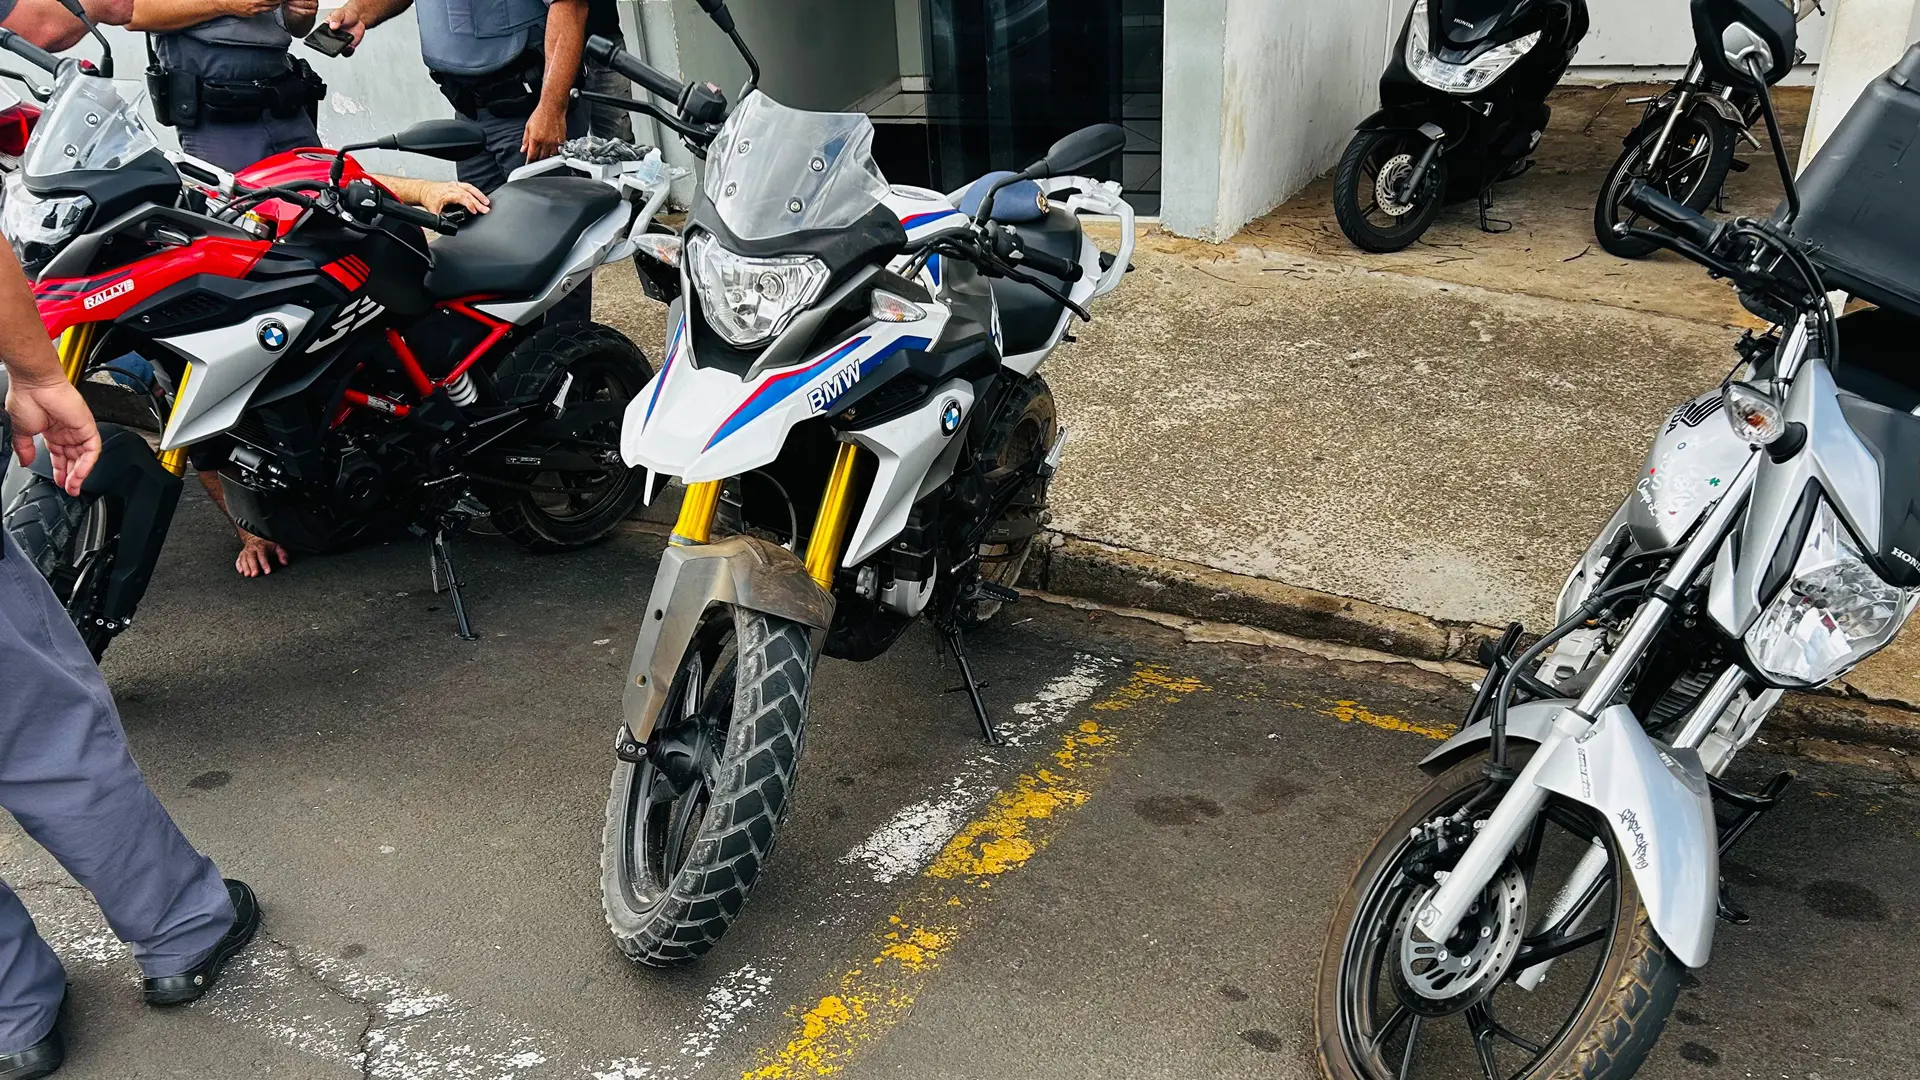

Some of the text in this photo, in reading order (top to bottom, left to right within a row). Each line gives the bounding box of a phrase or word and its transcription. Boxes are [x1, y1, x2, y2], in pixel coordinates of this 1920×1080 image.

[1453, 18, 1474, 29] HONDA
[84, 279, 135, 309] RALLYE
[806, 358, 861, 415] BMW
